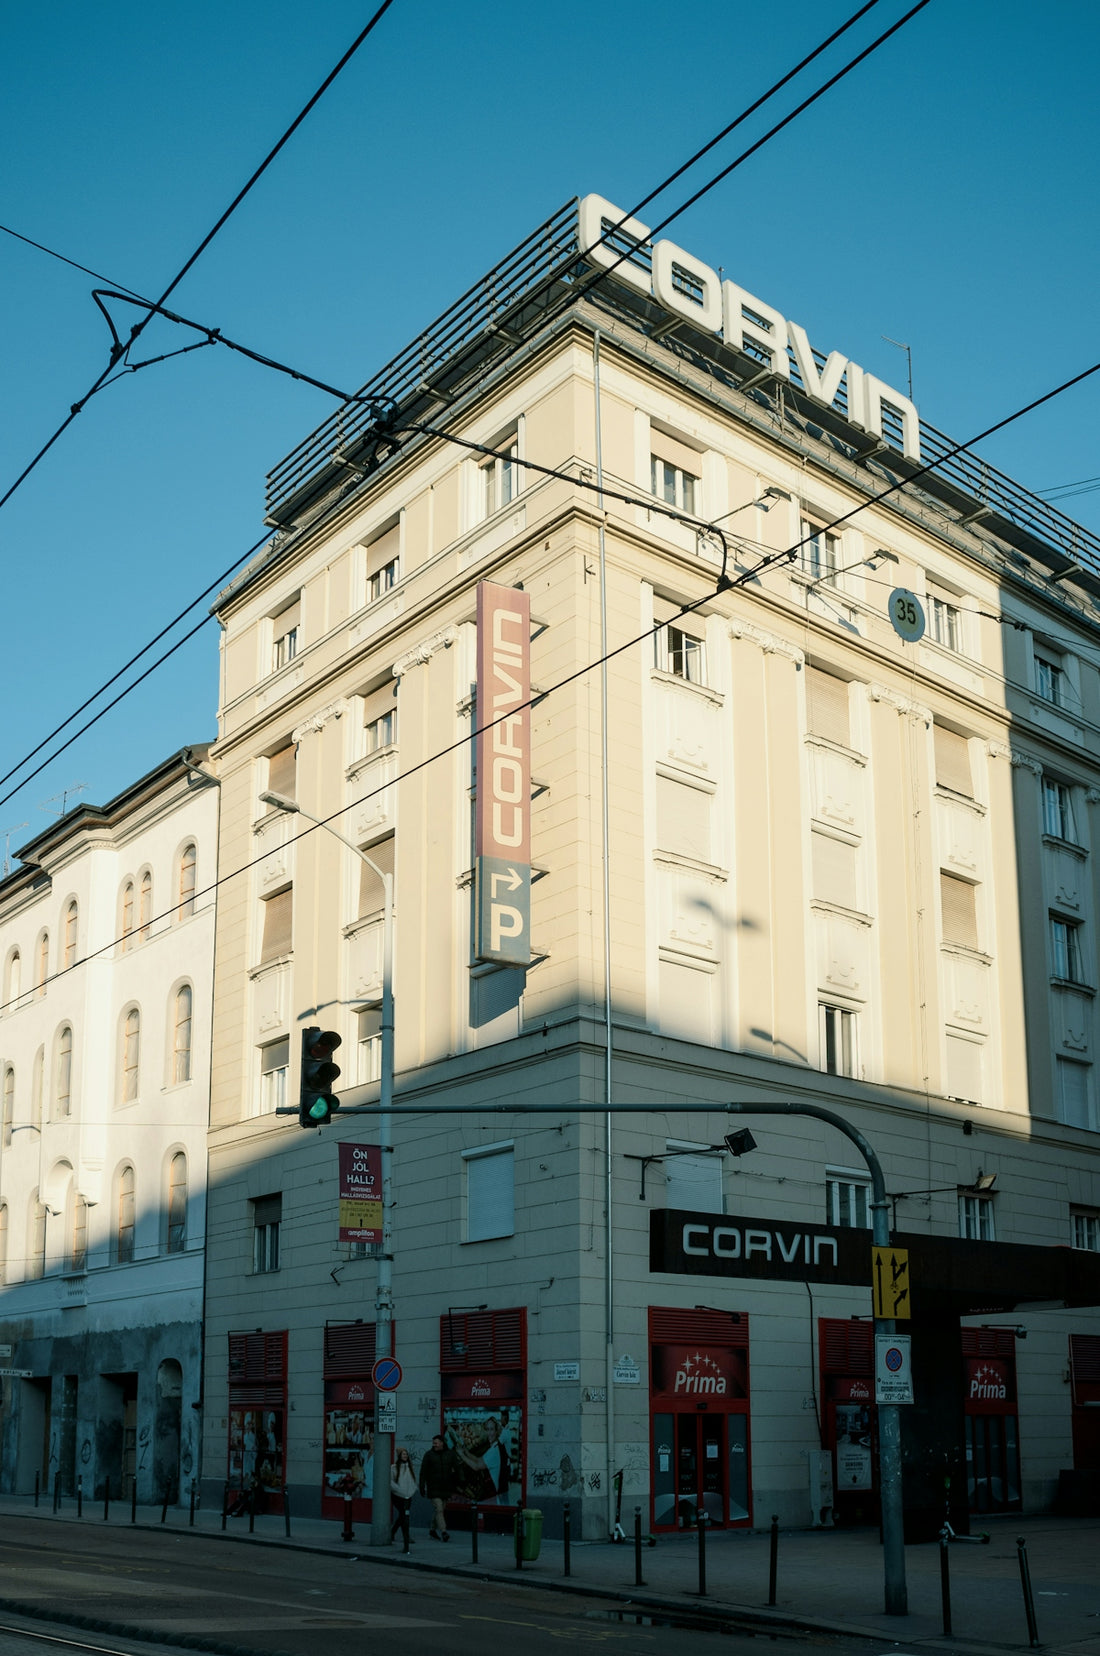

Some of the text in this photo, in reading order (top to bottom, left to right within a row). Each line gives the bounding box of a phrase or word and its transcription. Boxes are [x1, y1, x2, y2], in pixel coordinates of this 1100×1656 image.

[579, 193, 919, 464] CORVIN
[897, 598, 916, 624] 35
[492, 608, 523, 848] CORVIN
[491, 910, 524, 950] P
[352, 1148, 368, 1160] ÖN
[352, 1161, 370, 1173] JÓL
[346, 1174, 375, 1185] HALL?
[682, 1223, 838, 1267] CORVIN
